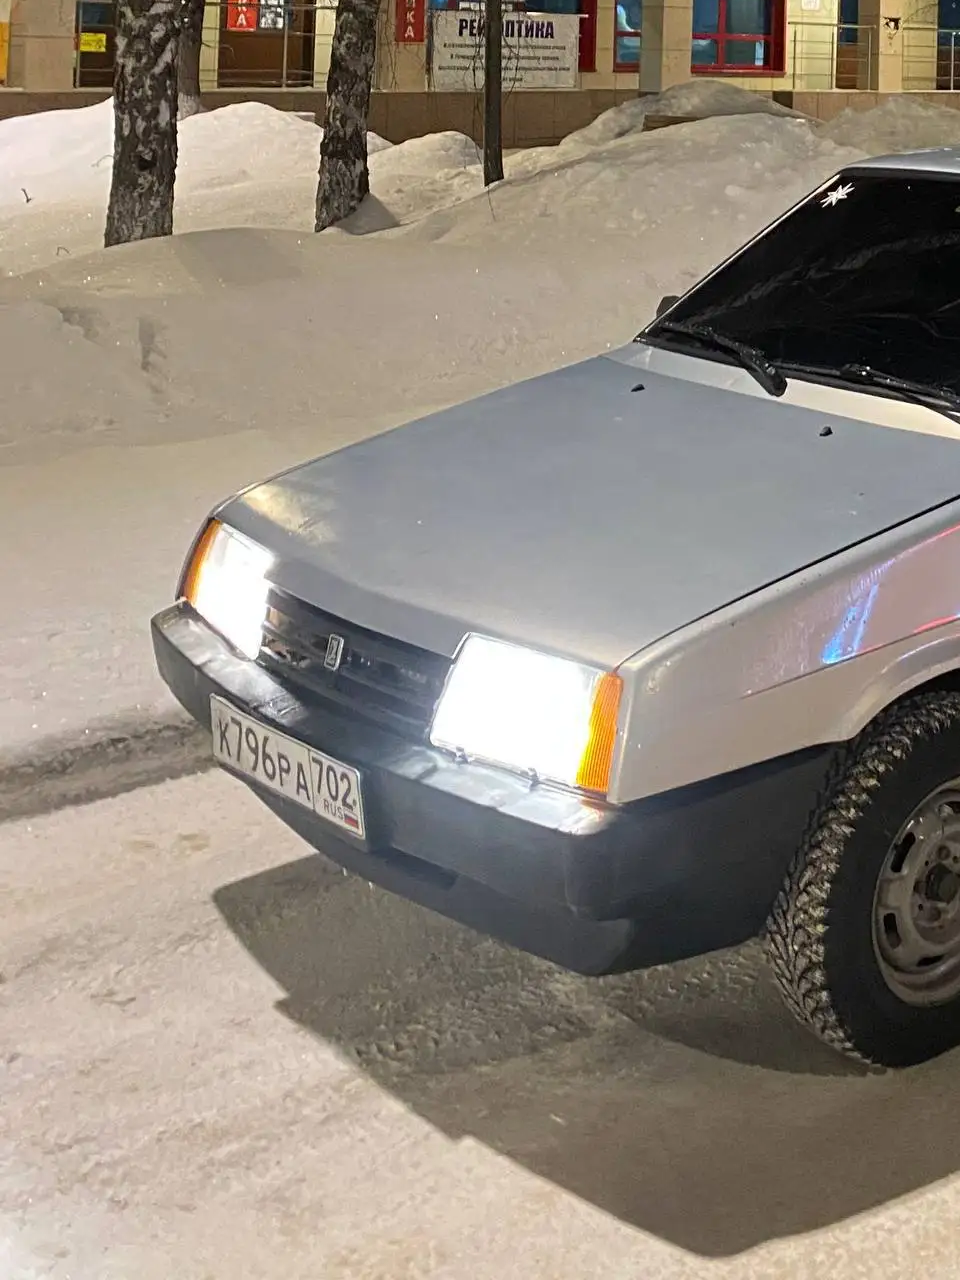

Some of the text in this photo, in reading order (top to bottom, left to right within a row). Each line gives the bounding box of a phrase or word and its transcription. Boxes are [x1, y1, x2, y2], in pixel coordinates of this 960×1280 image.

[218, 716, 354, 811] К796РА 702
[323, 798, 344, 820] RUS
